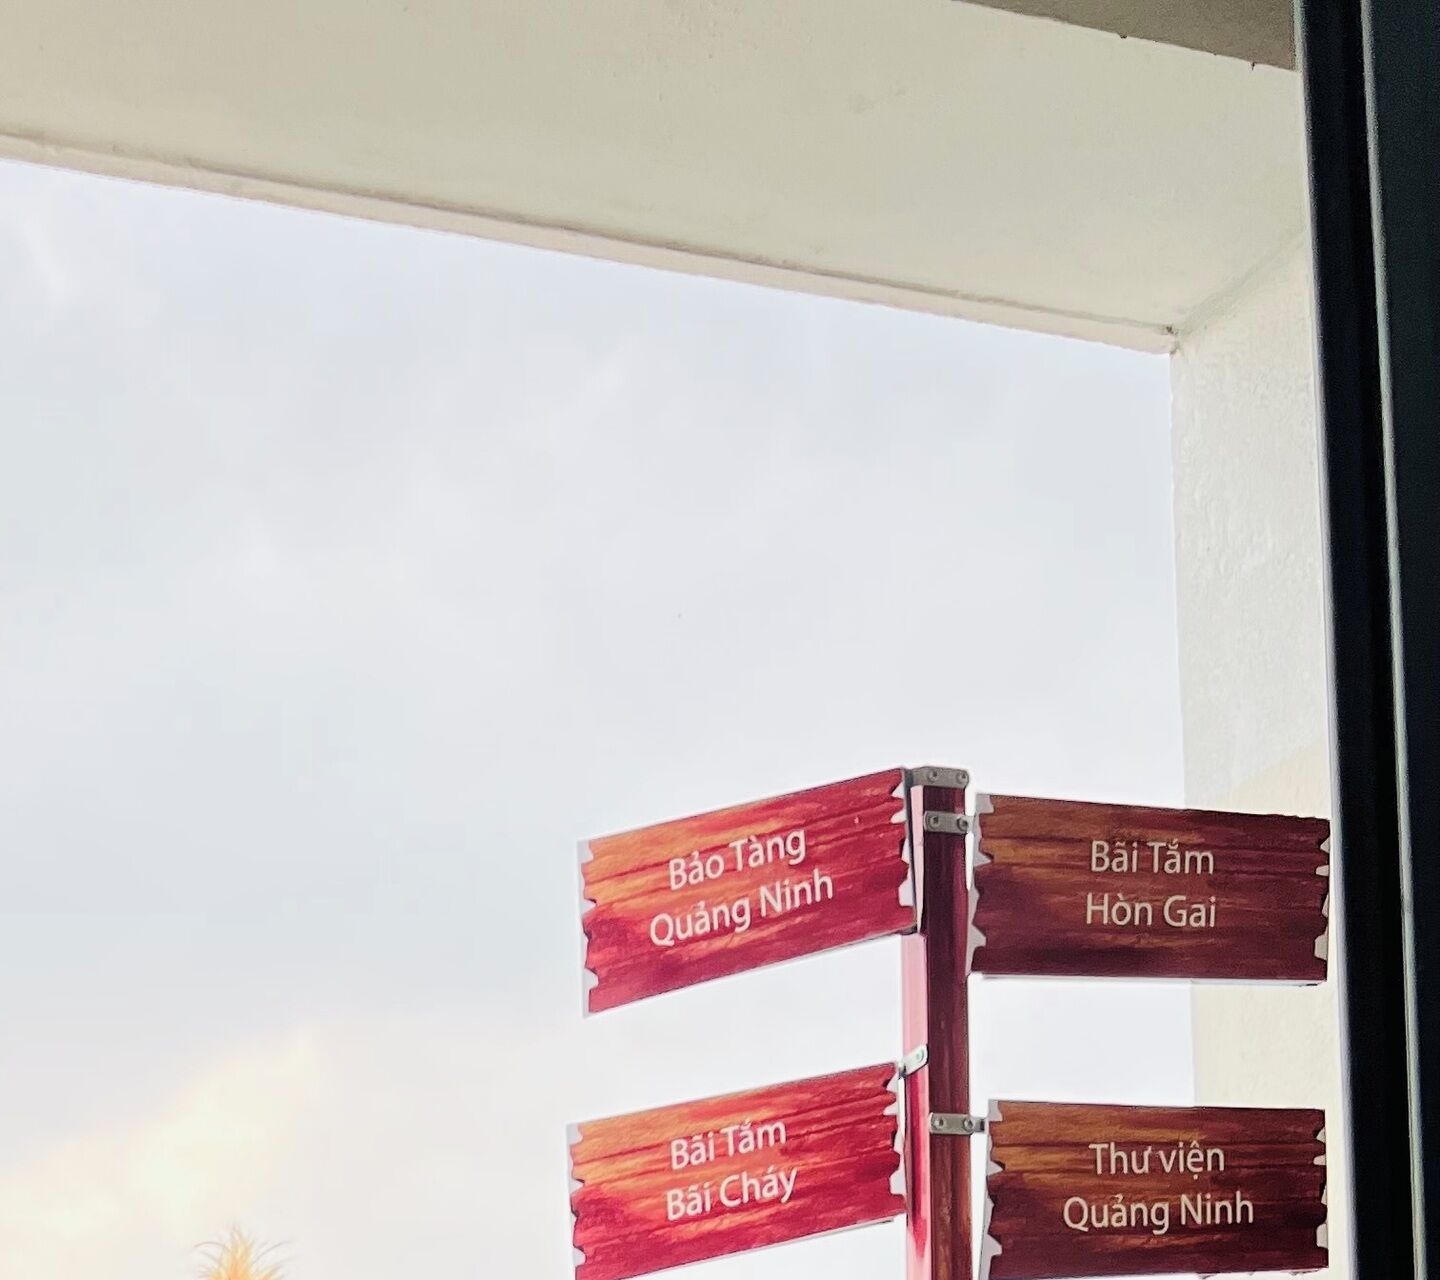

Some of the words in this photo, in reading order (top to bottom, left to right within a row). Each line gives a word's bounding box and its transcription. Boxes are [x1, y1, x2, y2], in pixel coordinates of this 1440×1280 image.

[668, 851, 725, 891] Bảo
[729, 829, 807, 871] Tàng
[1091, 840, 1138, 873] Bãi
[1146, 838, 1214, 875] Tắm
[649, 897, 751, 947] Quảng
[759, 867, 834, 917] Ninh
[1086, 892, 1153, 926] Hòn
[1163, 895, 1217, 928] Gai
[670, 1131, 714, 1170] Bãi
[719, 1118, 787, 1157] Tắm
[1088, 1142, 1152, 1175] Thư
[1158, 1140, 1225, 1180] viện
[666, 1181, 711, 1221] Bãi
[719, 1165, 798, 1207] Cháy
[1063, 1193, 1170, 1235] Quảng
[1180, 1190, 1254, 1225] Ninh
